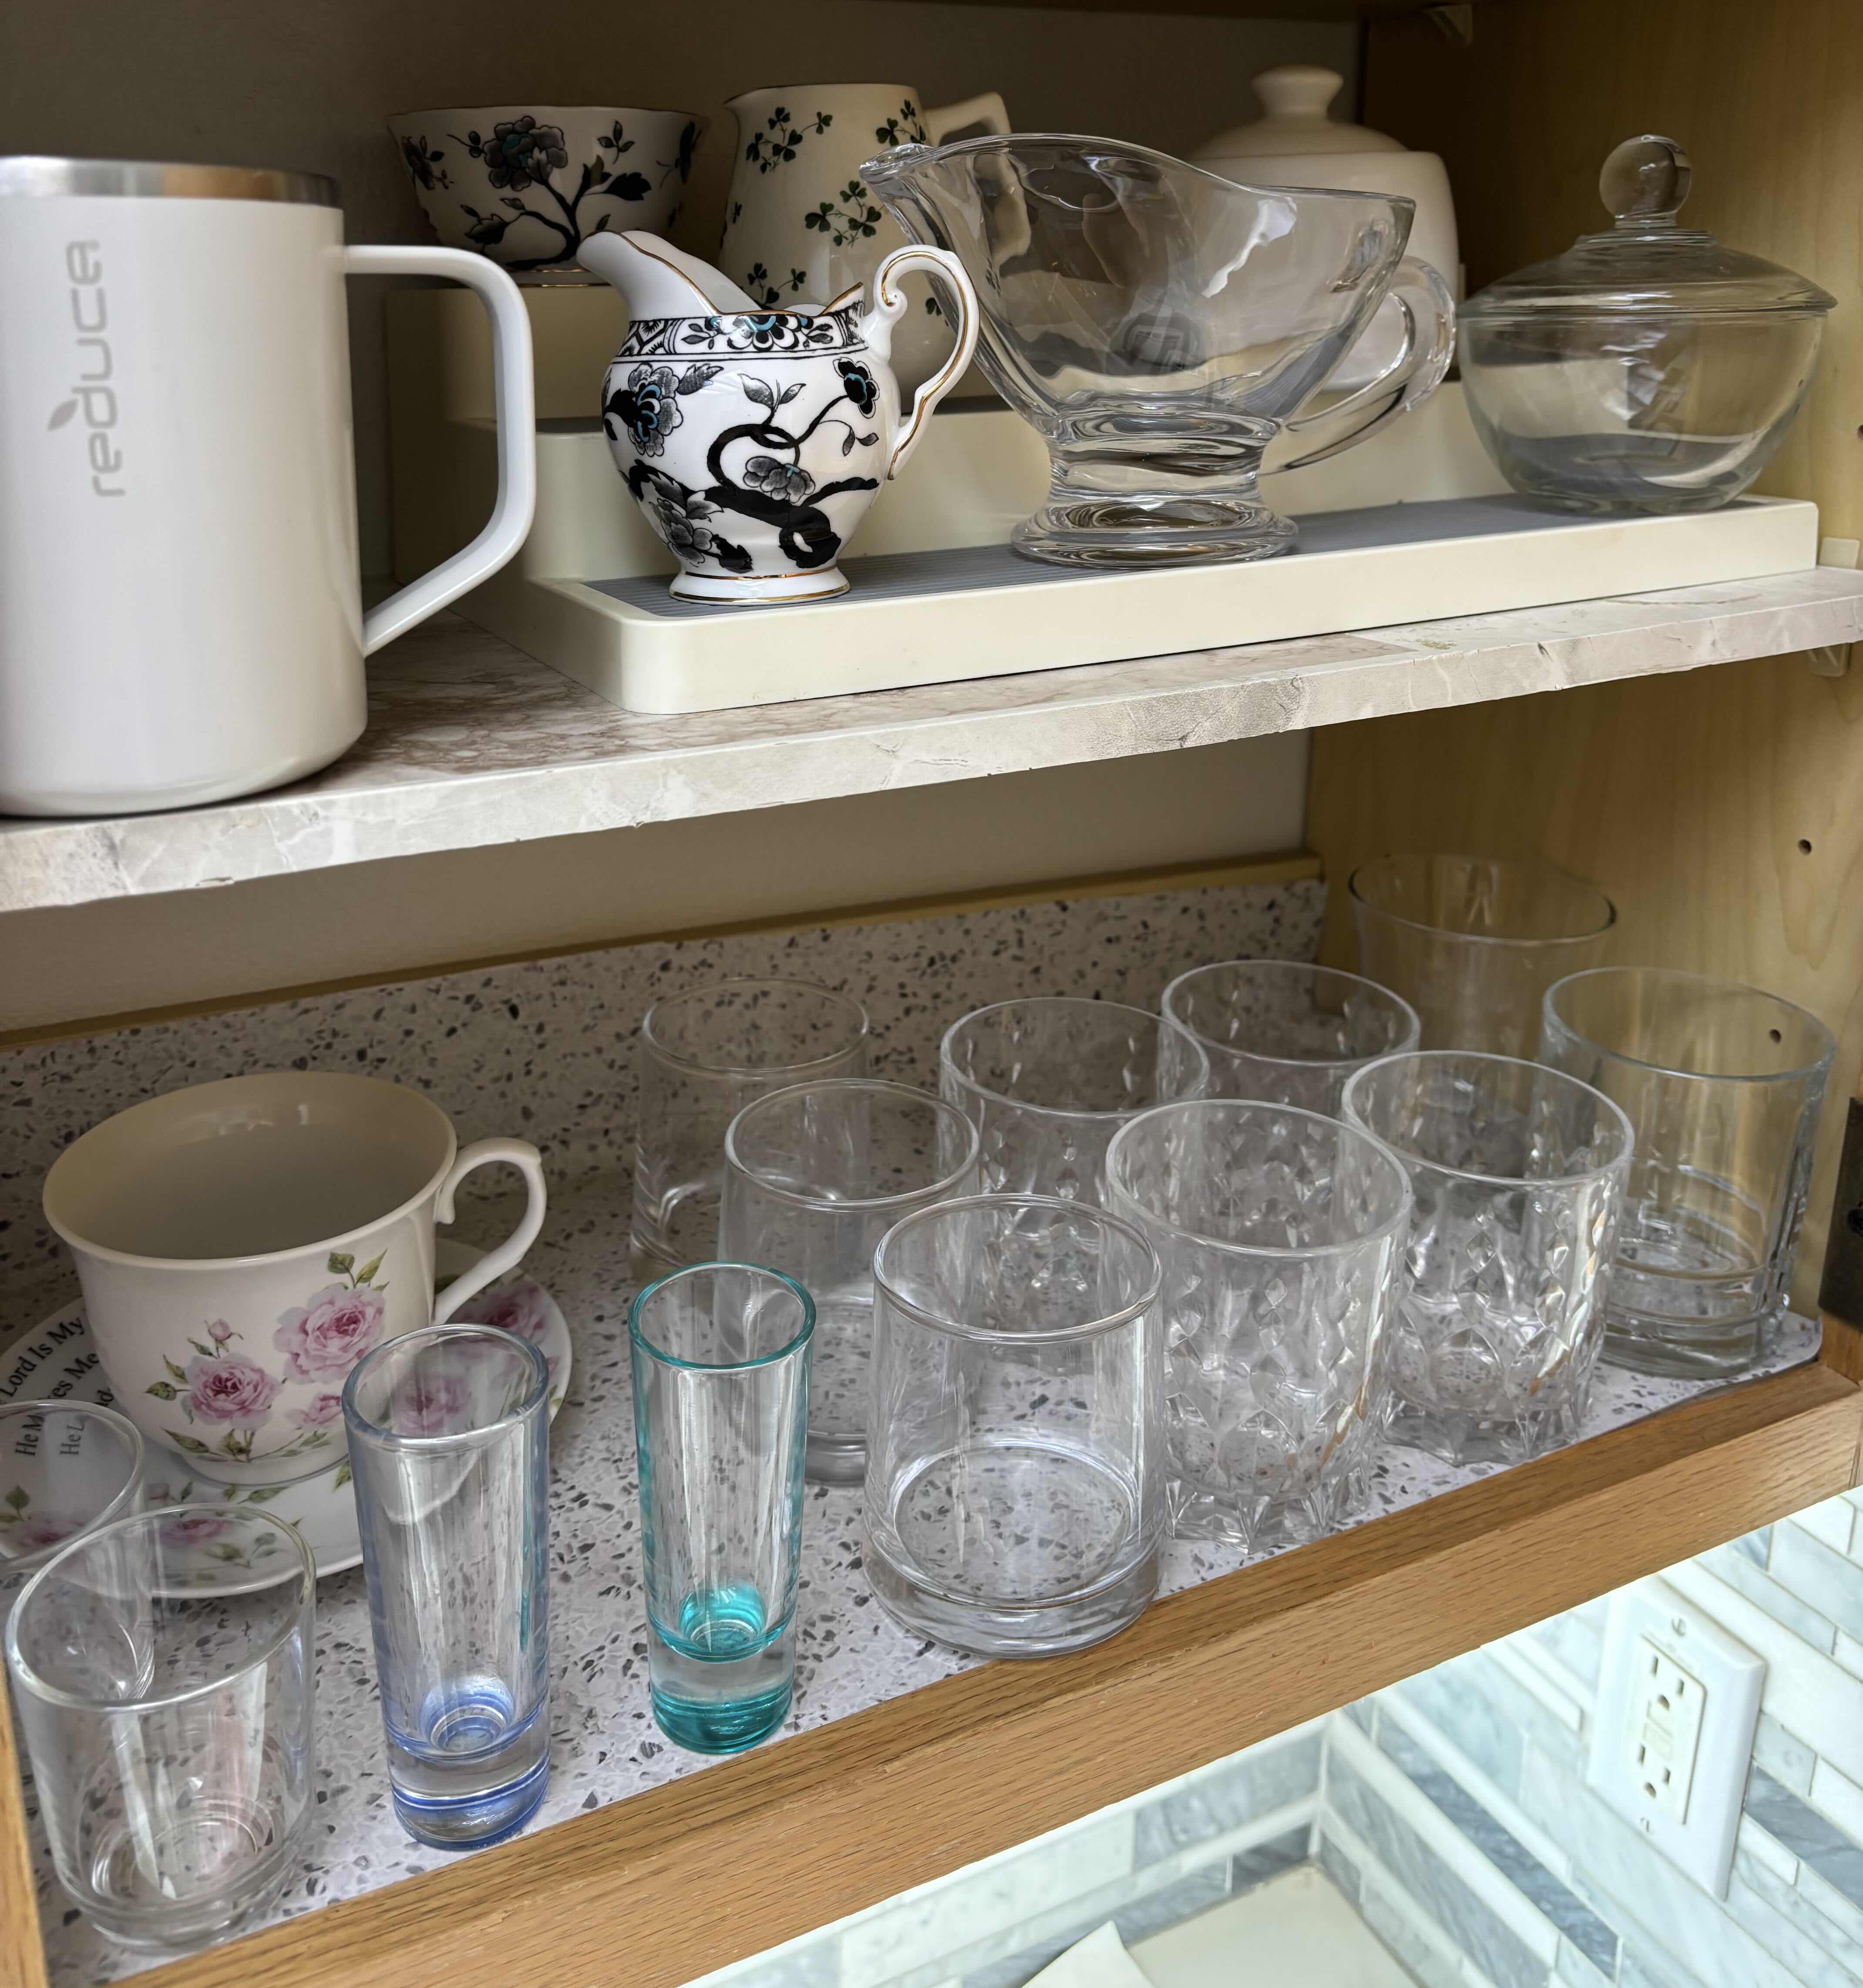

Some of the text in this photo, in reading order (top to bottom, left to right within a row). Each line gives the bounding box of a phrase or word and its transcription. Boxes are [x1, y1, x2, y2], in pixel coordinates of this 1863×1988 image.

[65, 240, 126, 497] reduce
[0, 1316, 85, 1397] Lord Is My
[15, 1434, 39, 1456] He
[64, 1352, 100, 1380] Me
[59, 1434, 81, 1455] He
